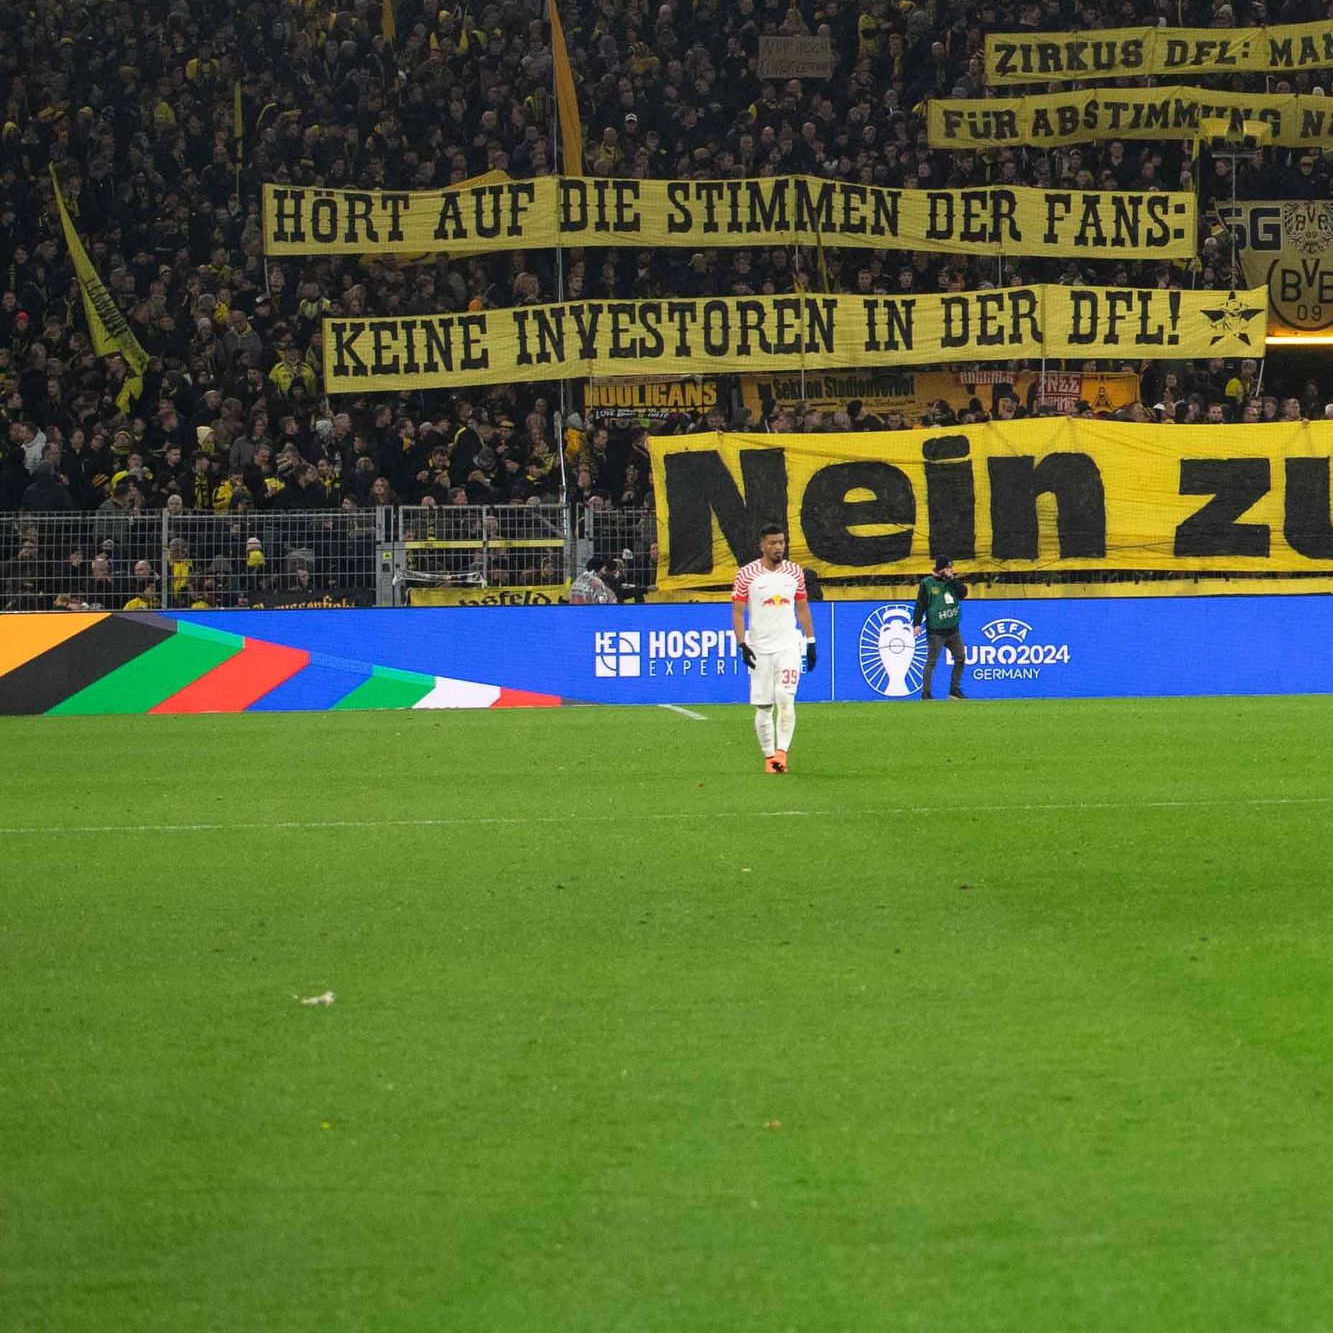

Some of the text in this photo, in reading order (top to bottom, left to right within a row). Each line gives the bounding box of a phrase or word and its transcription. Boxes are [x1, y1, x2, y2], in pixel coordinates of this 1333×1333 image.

[993, 38, 1145, 75] ZIRKUS
[1164, 39, 1252, 67] DFL:
[944, 108, 1018, 139] FÜR
[1031, 99, 1281, 137] ABSTIMMUNG
[272, 177, 1187, 248] HÖRT AUF DIE STIMMEN DER FANS:
[1296, 304, 1323, 322] 09
[331, 289, 1182, 376] KEINE INVESTOREN IN DER DFL!
[583, 382, 718, 407] HOOLIGANS
[663, 434, 1107, 575] Nein
[649, 630, 808, 659] HOSPIT
[983, 622, 1029, 644] UEFA
[649, 659, 808, 677] EXPERIE
[781, 668, 798, 685] 39
[972, 667, 1041, 681] GERMANY
